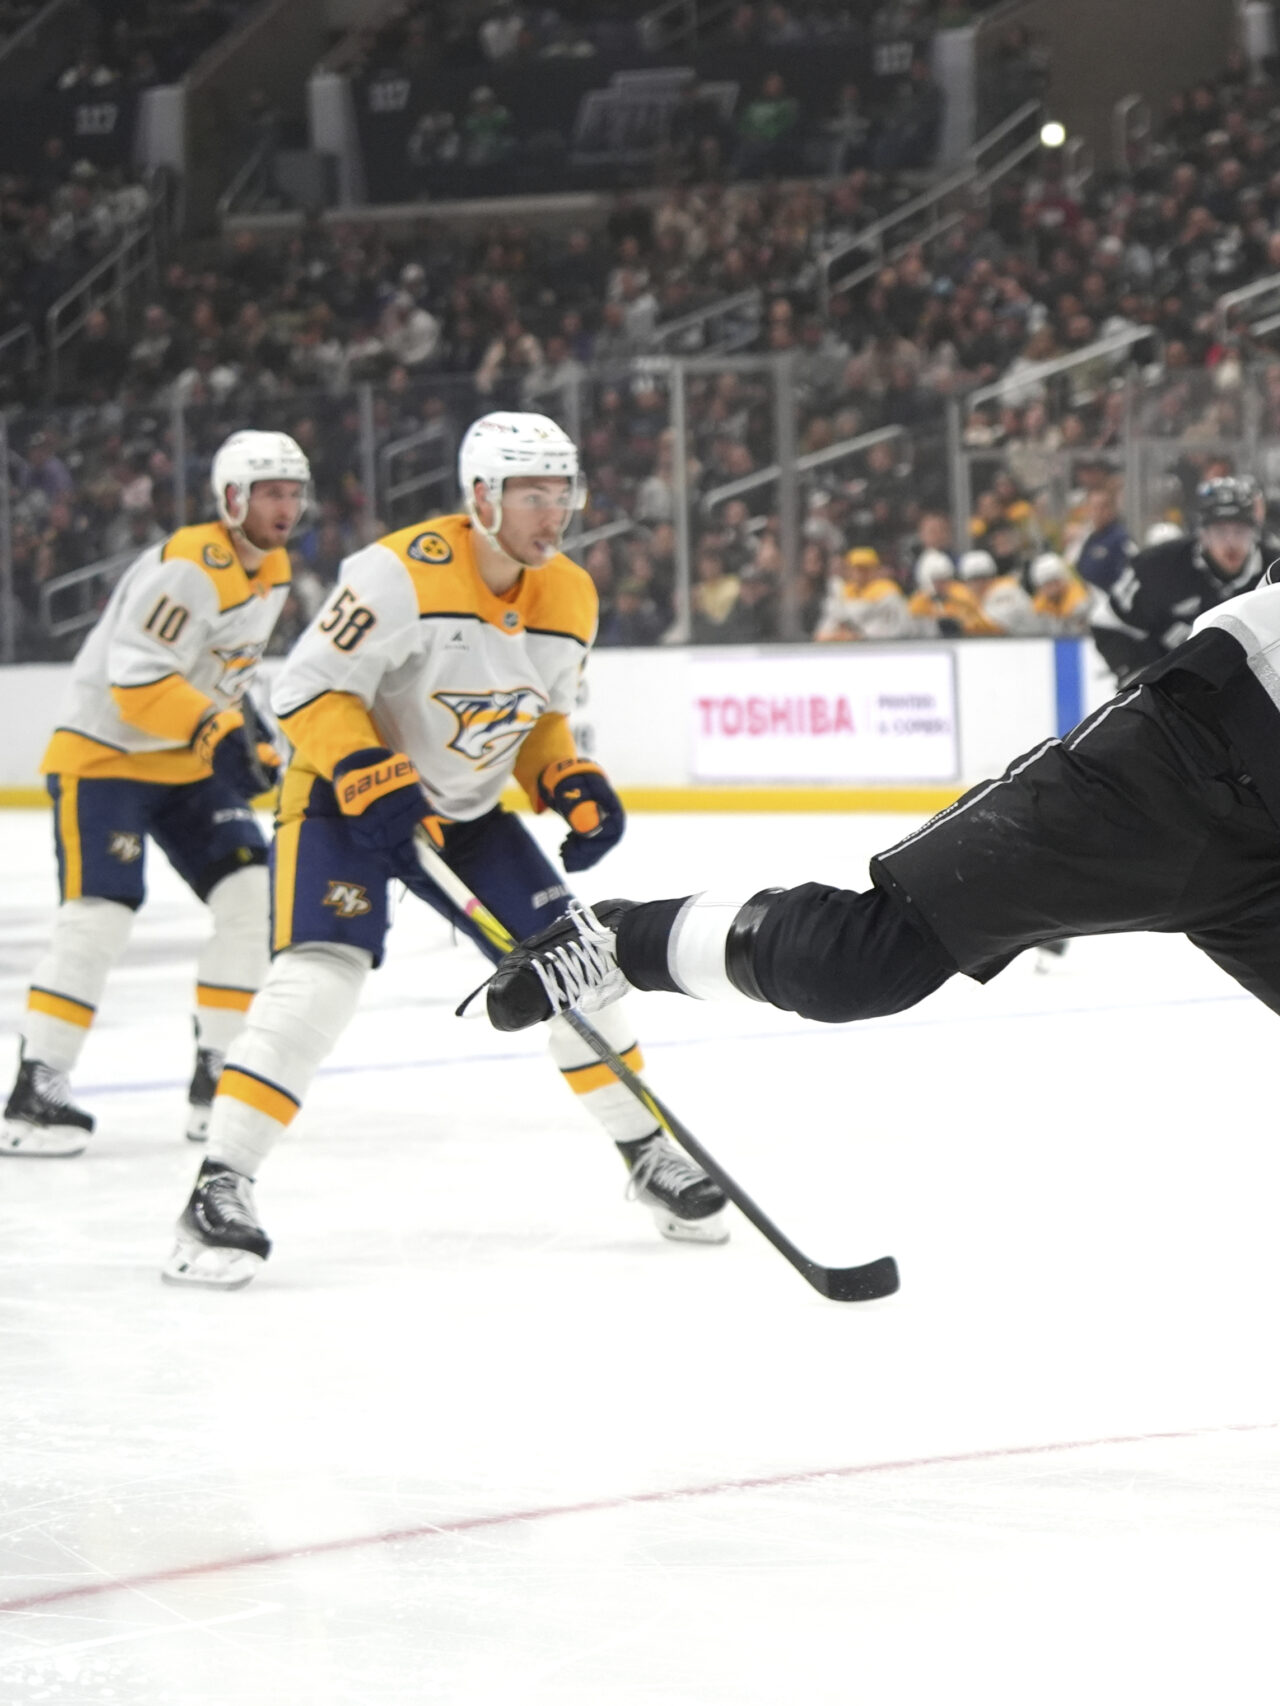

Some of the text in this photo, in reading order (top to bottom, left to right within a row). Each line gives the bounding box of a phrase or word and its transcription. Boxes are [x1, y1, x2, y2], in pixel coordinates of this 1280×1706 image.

[144, 594, 191, 645] 10
[318, 584, 378, 655] 58
[696, 696, 856, 736] TOSHIBA
